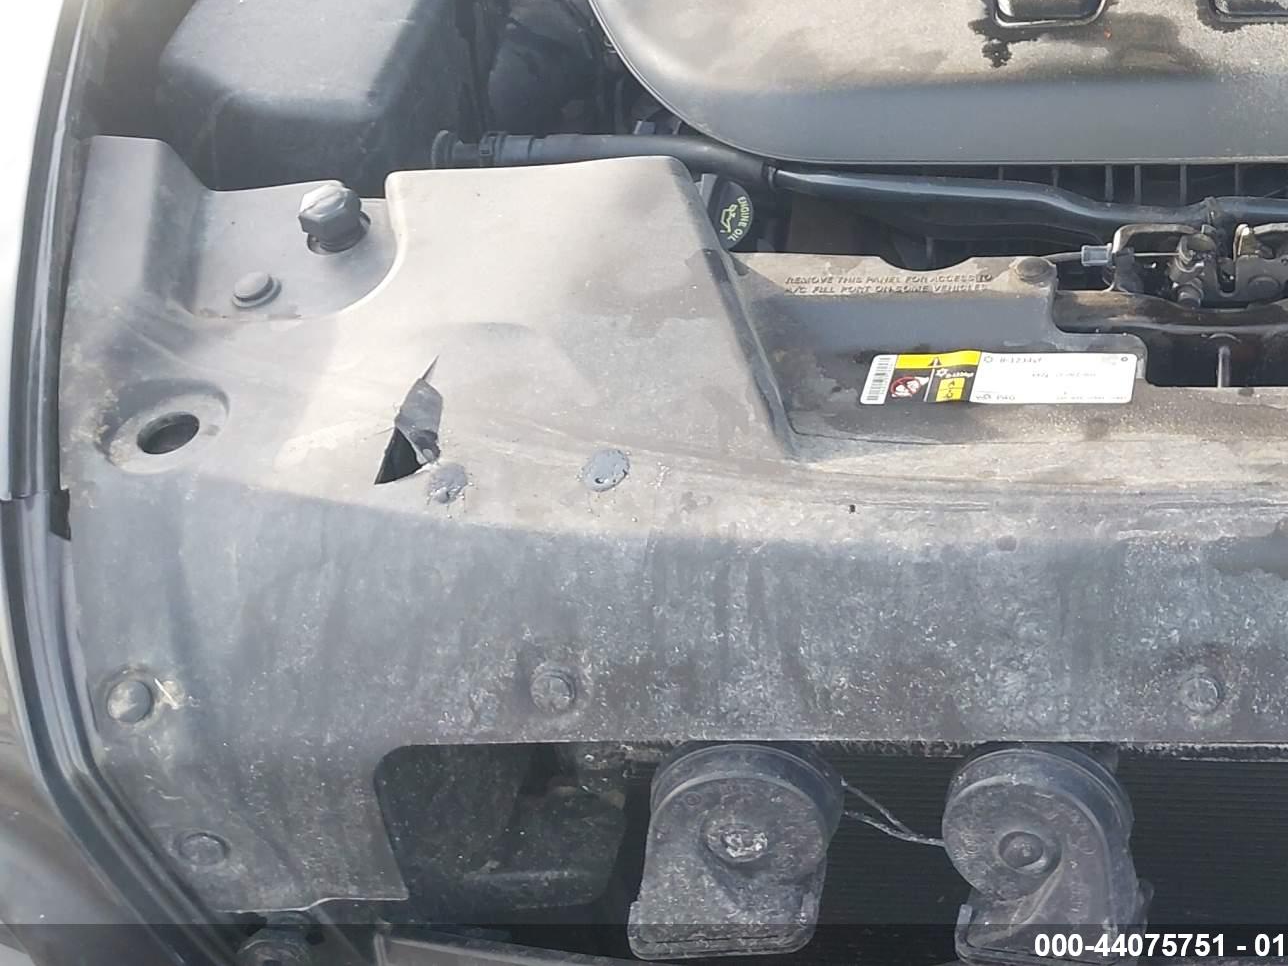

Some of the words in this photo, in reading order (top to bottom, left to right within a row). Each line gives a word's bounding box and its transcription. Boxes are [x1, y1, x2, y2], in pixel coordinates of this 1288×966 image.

[737, 196, 750, 227] ENGINE
[727, 228, 743, 242] OIL
[785, 276, 834, 285] REMOVE
[839, 276, 863, 285] THIS
[866, 275, 899, 284] PANEL
[905, 274, 928, 283] FOR
[930, 274, 976, 283] ACCESS
[977, 274, 994, 283] TO
[812, 286, 836, 294] FILL
[840, 285, 872, 294] PORT
[876, 285, 896, 293] ON
[896, 284, 931, 293] SOME
[932, 282, 989, 293] VEHICLES
